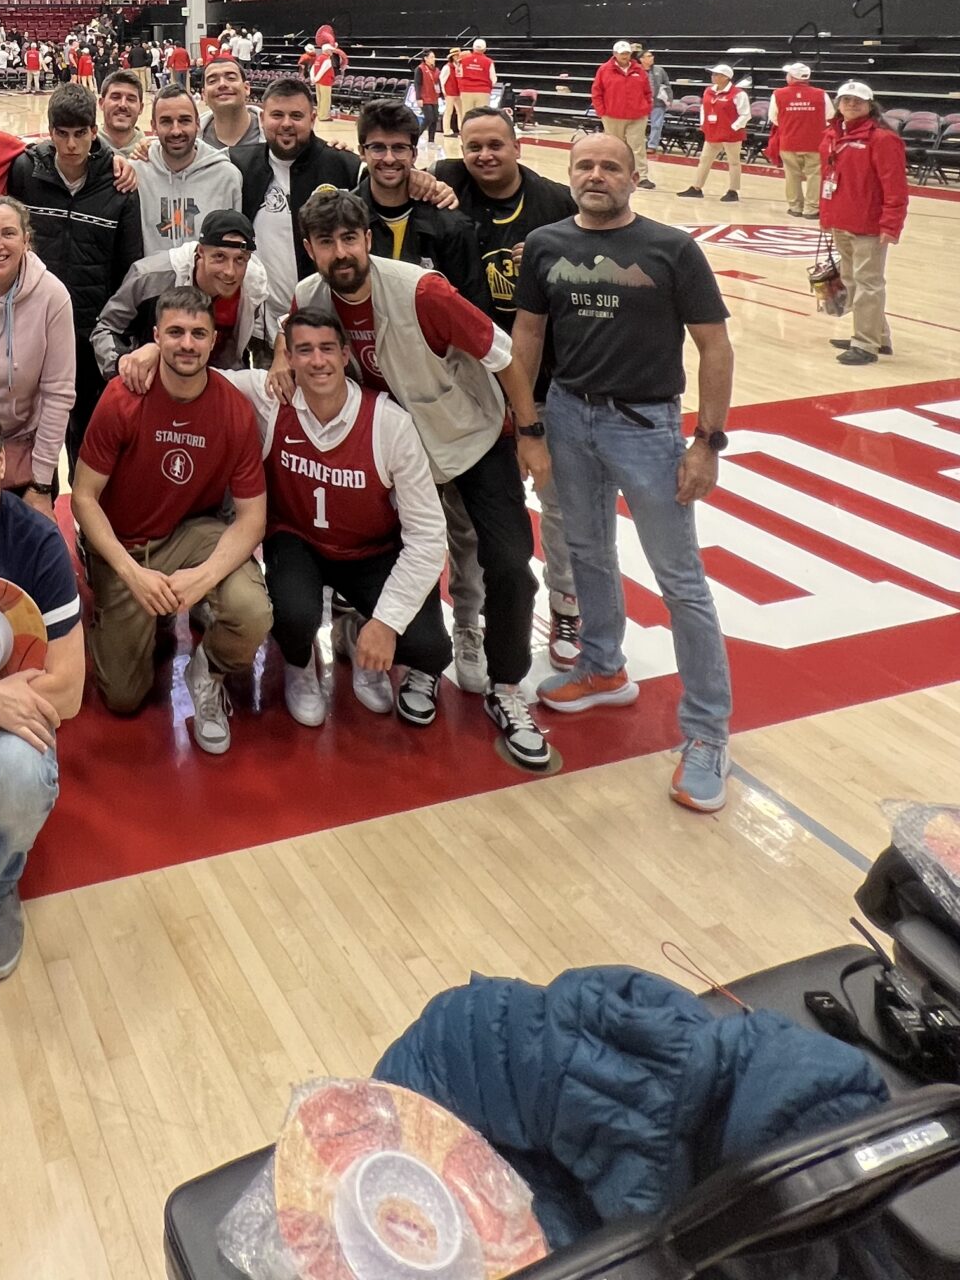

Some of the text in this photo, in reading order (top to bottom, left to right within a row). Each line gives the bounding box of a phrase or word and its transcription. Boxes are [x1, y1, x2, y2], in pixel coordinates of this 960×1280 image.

[571, 292, 620, 308] BIG SUR
[577, 308, 615, 319] CALIFORNIA
[155, 430, 206, 448] STANFORD
[280, 449, 367, 489] STANFORD
[313, 486, 329, 528] 1
